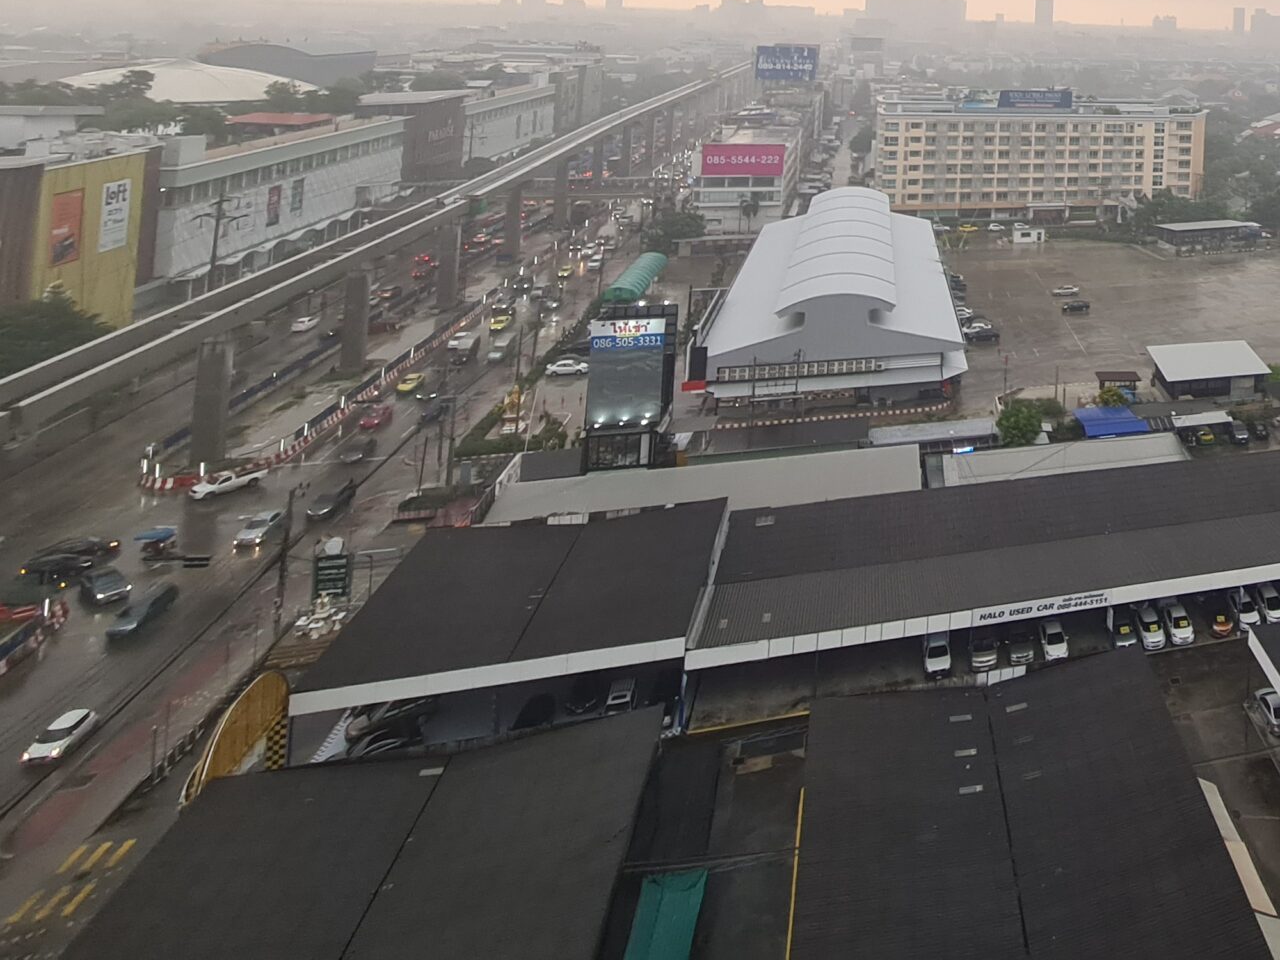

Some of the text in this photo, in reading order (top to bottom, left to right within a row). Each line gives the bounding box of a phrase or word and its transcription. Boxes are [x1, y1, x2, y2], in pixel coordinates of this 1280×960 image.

[706, 155, 780, 164] 085-5544-222
[593, 336, 662, 349] 086-505-3331
[1008, 606, 1033, 617] USED
[1036, 602, 1055, 612] CAR
